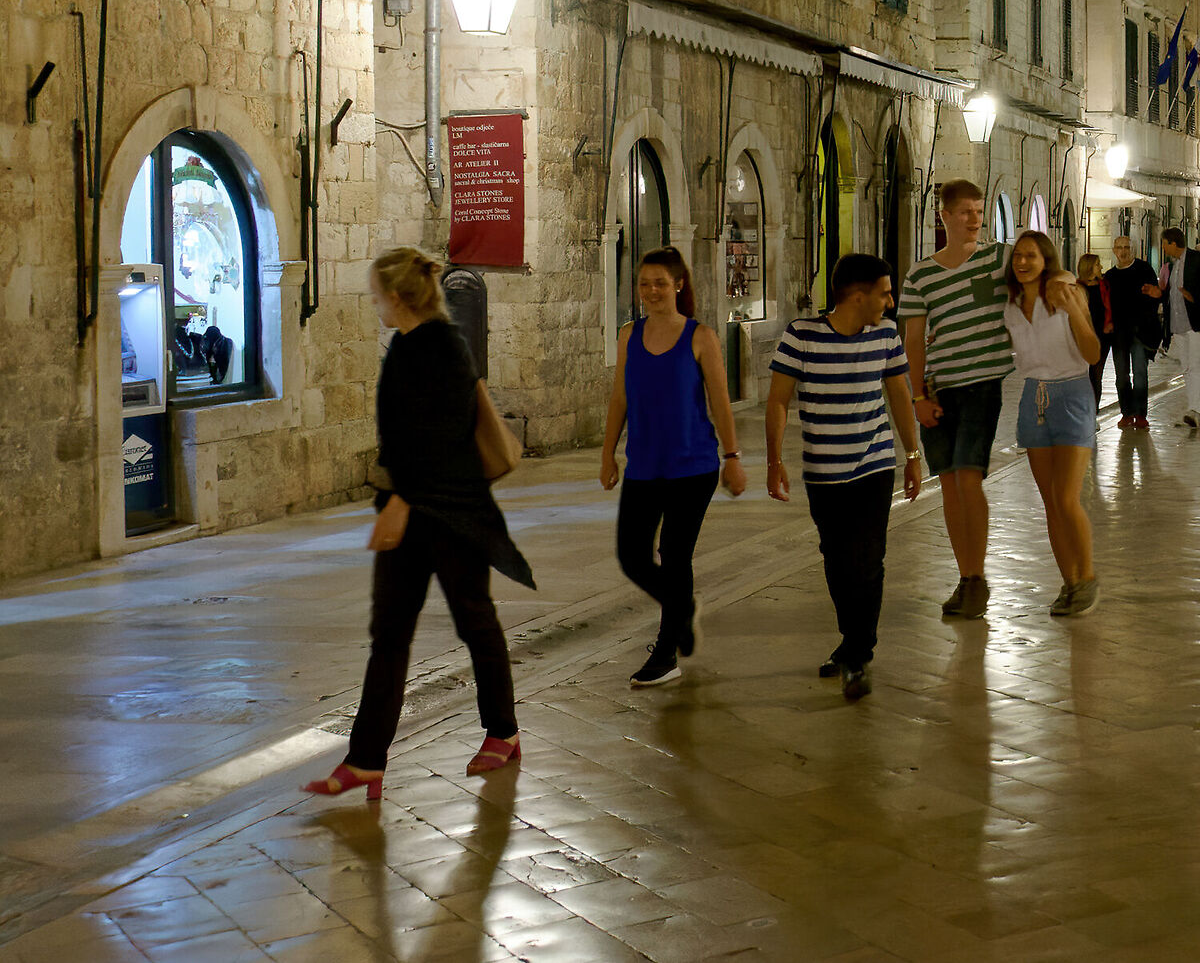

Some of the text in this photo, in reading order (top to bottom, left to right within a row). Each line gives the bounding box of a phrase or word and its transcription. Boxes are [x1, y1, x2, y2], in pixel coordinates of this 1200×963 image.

[465, 160, 491, 168] ATELIER
[454, 171, 490, 179] NOSTALGIA
[507, 177, 520, 185] shop
[476, 189, 503, 197] STONES
[455, 197, 492, 205] JEWELLERY
